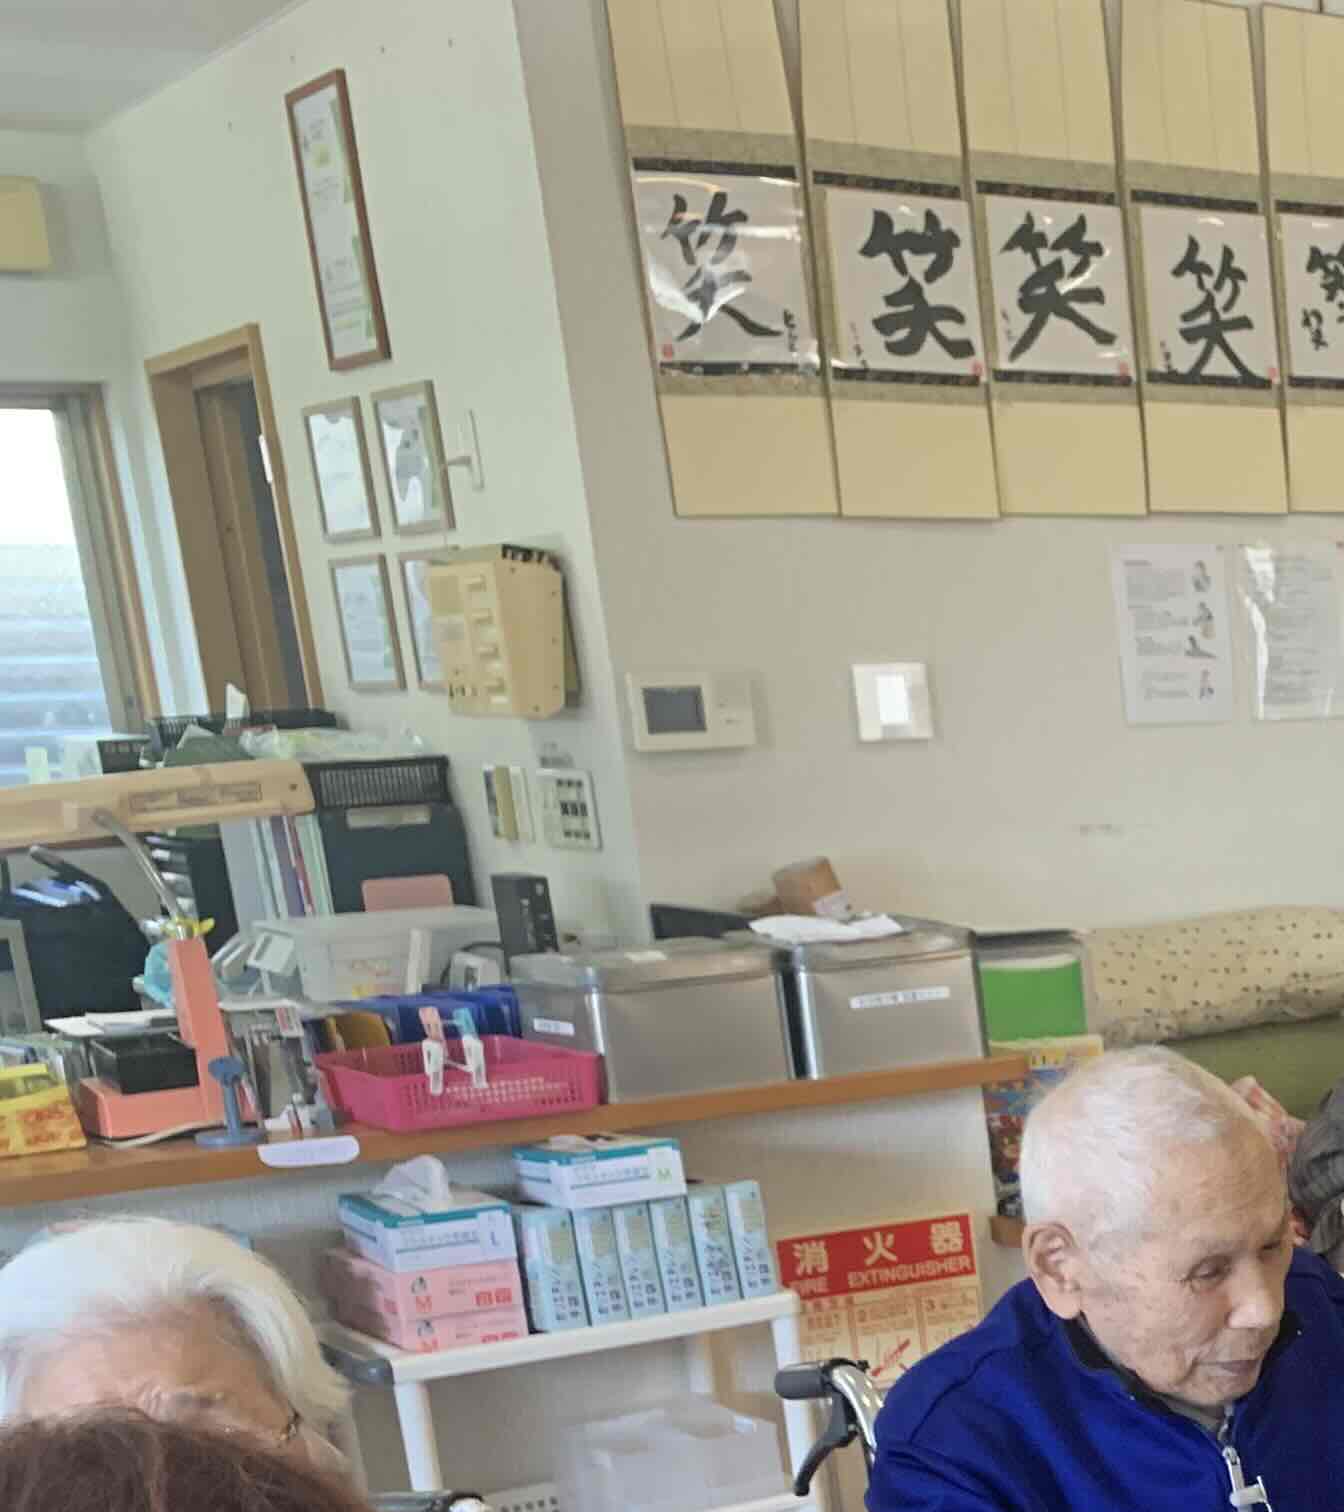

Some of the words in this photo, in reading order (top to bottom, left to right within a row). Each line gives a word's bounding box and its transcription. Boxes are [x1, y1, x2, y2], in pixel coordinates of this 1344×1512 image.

[661, 191, 782, 341] 笑
[860, 208, 975, 359] 笑
[1000, 211, 1117, 361] 笑
[1172, 235, 1256, 381] 笑
